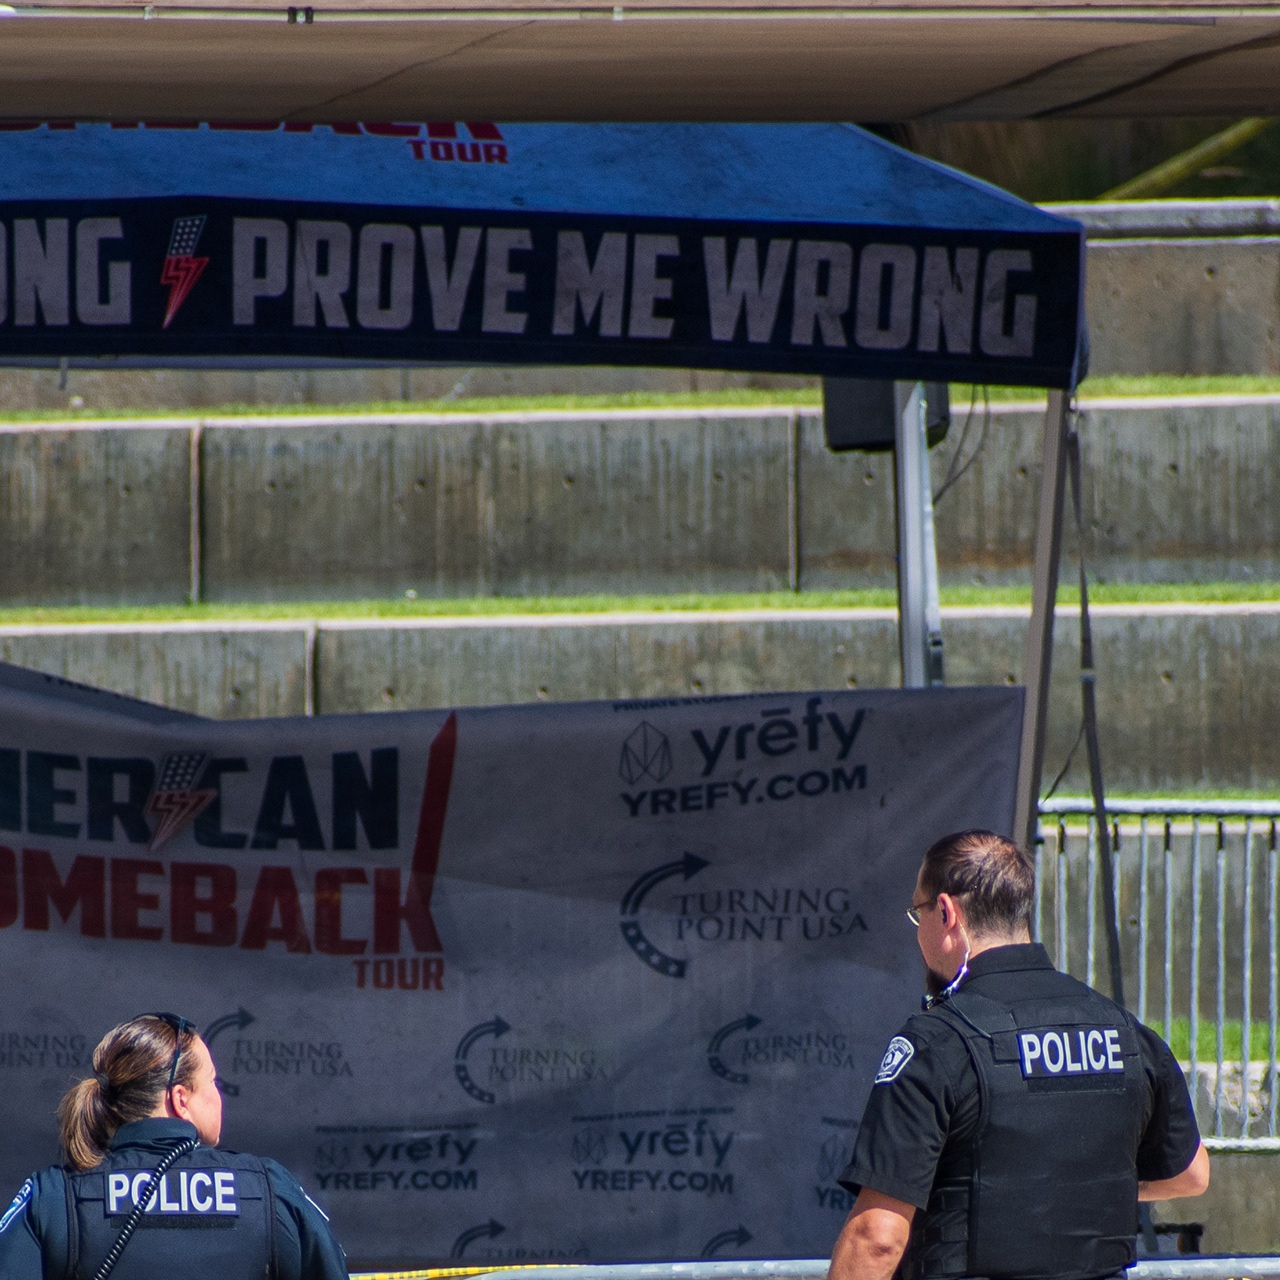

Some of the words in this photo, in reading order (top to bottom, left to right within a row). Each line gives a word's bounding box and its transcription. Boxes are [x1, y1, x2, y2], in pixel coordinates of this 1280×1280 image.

[407, 139, 508, 165] TOUR
[232, 216, 533, 333] PROVE
[552, 230, 681, 340] ME
[703, 236, 1038, 358] WRONG
[619, 763, 869, 819] YREFY.COM
[673, 886, 851, 917] TURNING
[675, 916, 791, 942] POINT
[802, 912, 870, 942] USA
[352, 957, 445, 991] TOUR
[231, 1038, 343, 1061] TURNING
[742, 1031, 848, 1052] TURNING
[1020, 1029, 1125, 1075] POLICE
[231, 1056, 304, 1077] POINT
[310, 1059, 354, 1079] USA
[487, 1046, 597, 1067] TURNING
[817, 1051, 856, 1071] USA
[487, 1064, 560, 1083] POINT
[108, 1170, 238, 1215] POLICE
[314, 1169, 479, 1192] YREFY.COM
[571, 1169, 735, 1195] YREFY.COM
